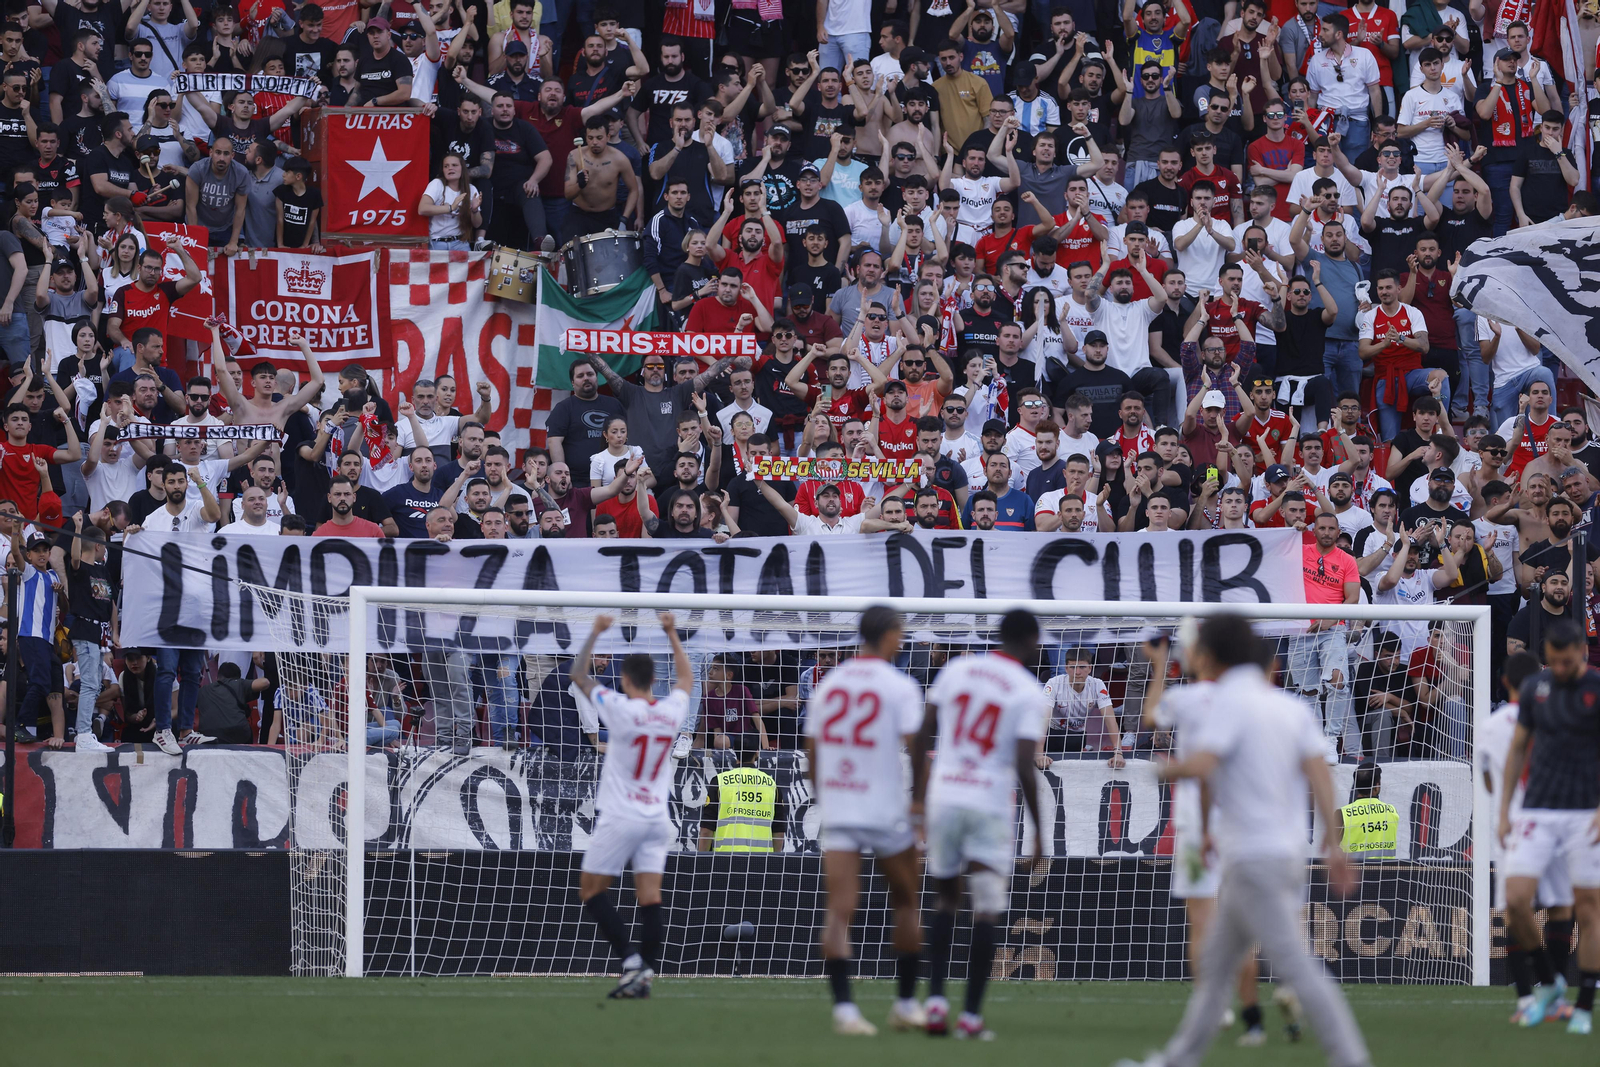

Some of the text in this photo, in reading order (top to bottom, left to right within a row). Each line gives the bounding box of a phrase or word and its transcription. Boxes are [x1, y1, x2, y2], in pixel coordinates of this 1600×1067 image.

[177, 73, 244, 92] BIRIS
[653, 89, 689, 104] 1975
[345, 113, 414, 130] ULTRAS
[203, 183, 228, 196] HOLL
[202, 195, 229, 208] STER
[961, 197, 993, 209] Playtika
[347, 210, 407, 226] 1975
[250, 300, 360, 324] CORONA
[243, 325, 369, 348] PRESENTE
[568, 329, 653, 354] BIRIS
[672, 335, 756, 355] NORTE
[1079, 386, 1122, 396] SEVILLA FC
[757, 460, 810, 477] SOLO
[847, 462, 919, 479] SEVILLA
[1313, 577, 1326, 586] BET
[821, 688, 881, 748] 22
[952, 693, 1001, 756] 14
[631, 734, 673, 782] 17
[723, 773, 774, 788] SEGURIDAD
[735, 790, 763, 804] 1595
[733, 807, 772, 818] PROSEGUR
[1346, 803, 1394, 817] SEGURIDAD
[1361, 820, 1389, 834] 1545
[1360, 841, 1395, 850] PROSEGUR
